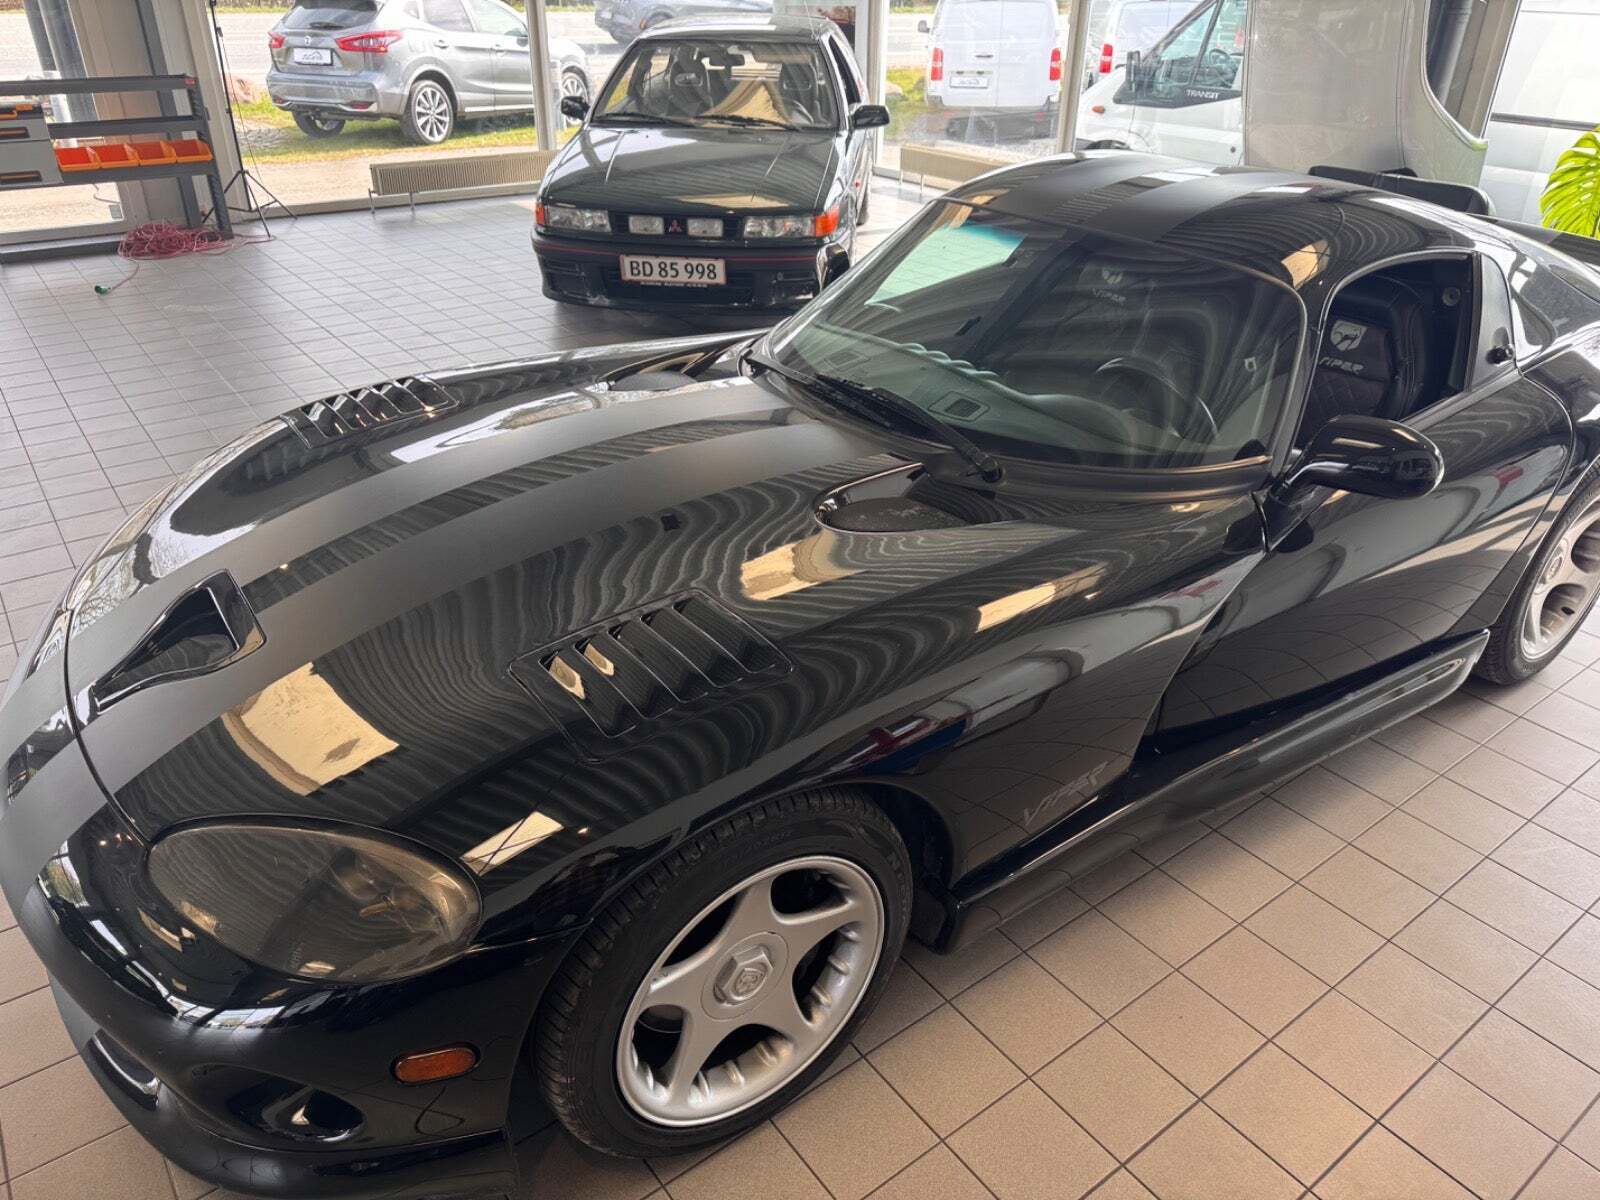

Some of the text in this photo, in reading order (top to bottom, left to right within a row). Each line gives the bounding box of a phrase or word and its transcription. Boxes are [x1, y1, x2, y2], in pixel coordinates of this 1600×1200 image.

[1186, 89, 1220, 99] TRANSIT
[630, 261, 717, 280] BD 85 998
